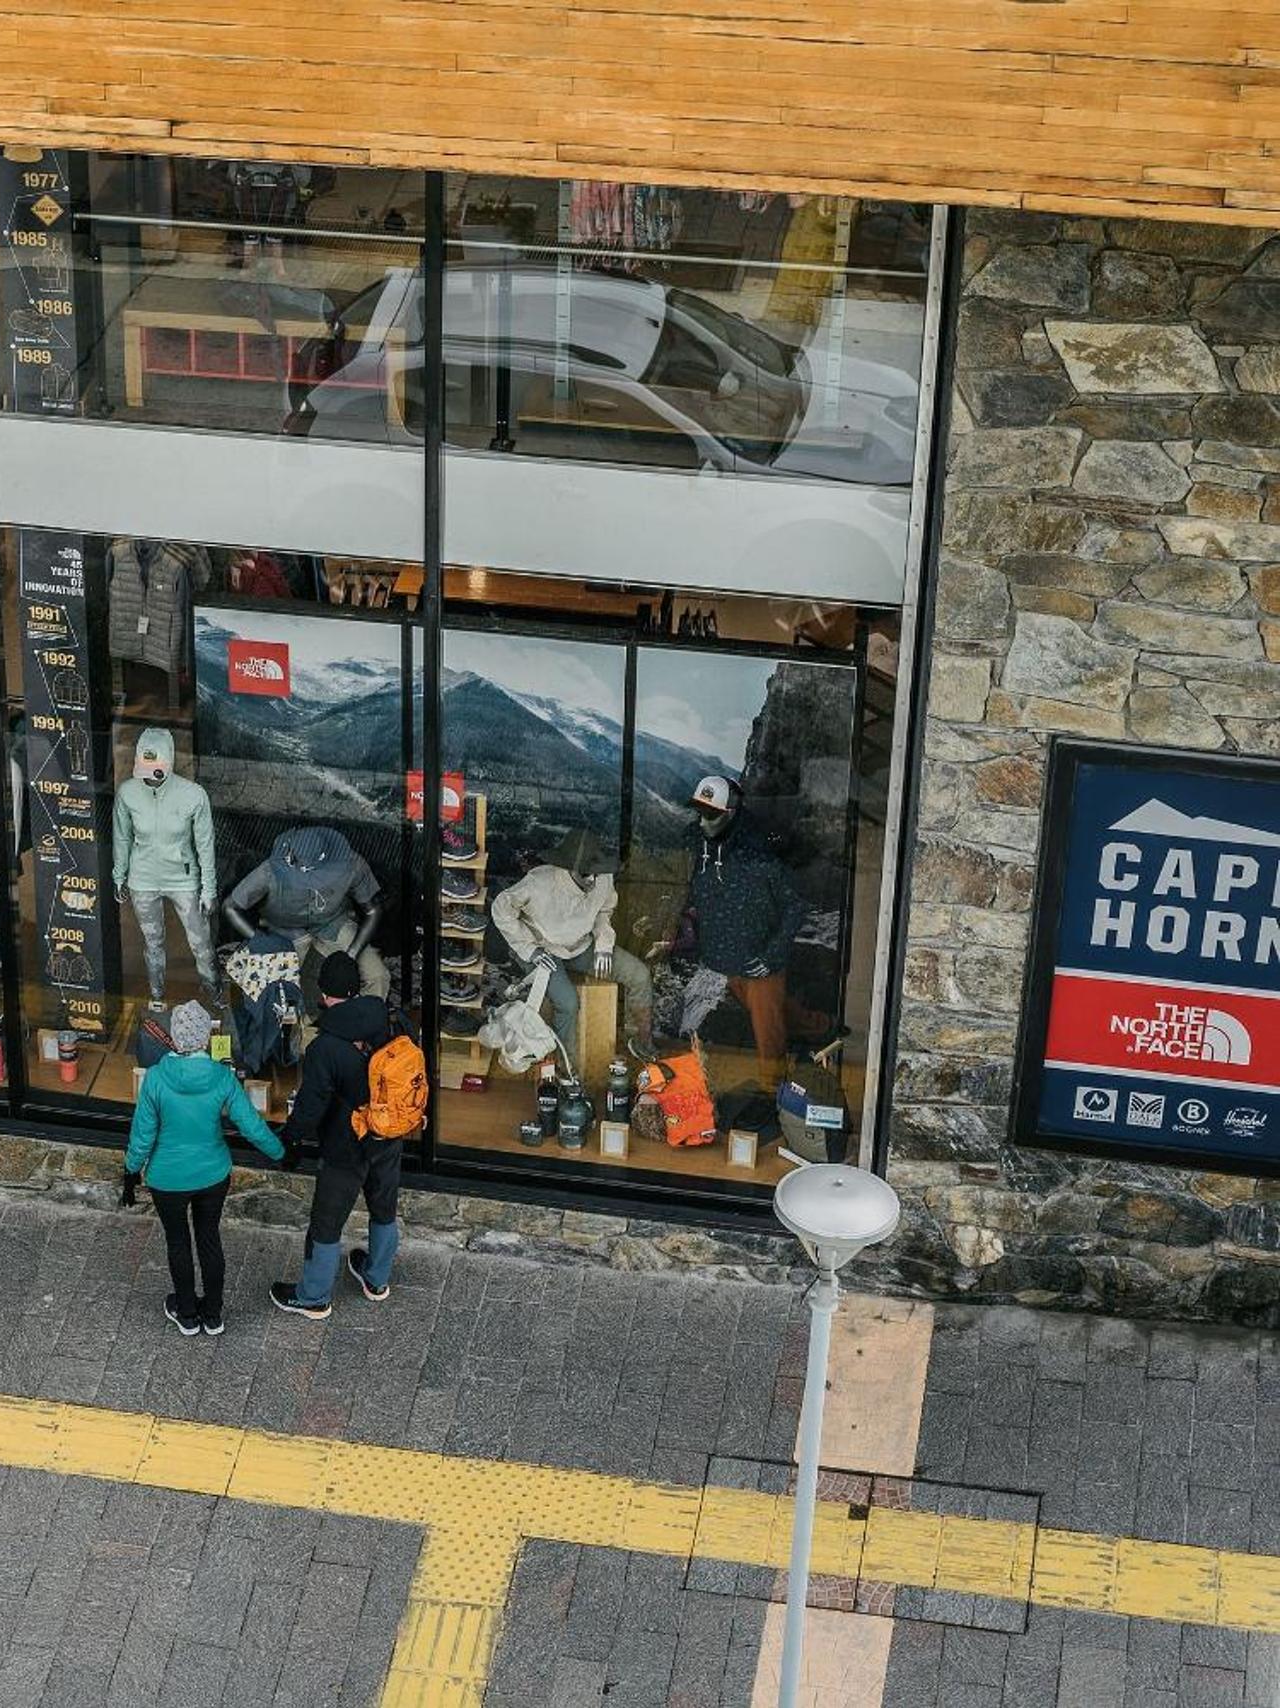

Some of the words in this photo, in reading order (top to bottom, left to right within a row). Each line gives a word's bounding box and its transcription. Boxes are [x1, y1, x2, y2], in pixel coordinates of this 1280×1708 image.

[22, 173, 58, 188] 1977
[11, 231, 47, 247] 1985
[37, 300, 73, 315] 1986
[17, 349, 52, 364] 1989
[50, 566, 83, 578] YEARS
[25, 582, 84, 597] INNOVATION
[28, 606, 60, 621] 1991
[42, 651, 76, 668] 1992
[31, 715, 64, 731] 1994
[37, 780, 69, 796] 1997
[60, 825, 95, 842] 2004
[62, 875, 97, 890] 2006
[1098, 841, 1280, 908] CAP
[51, 927, 85, 943] 2008
[69, 1000, 101, 1015] 2010
[1155, 1002, 1207, 1025] THE
[1110, 1015, 1204, 1043] NORTH
